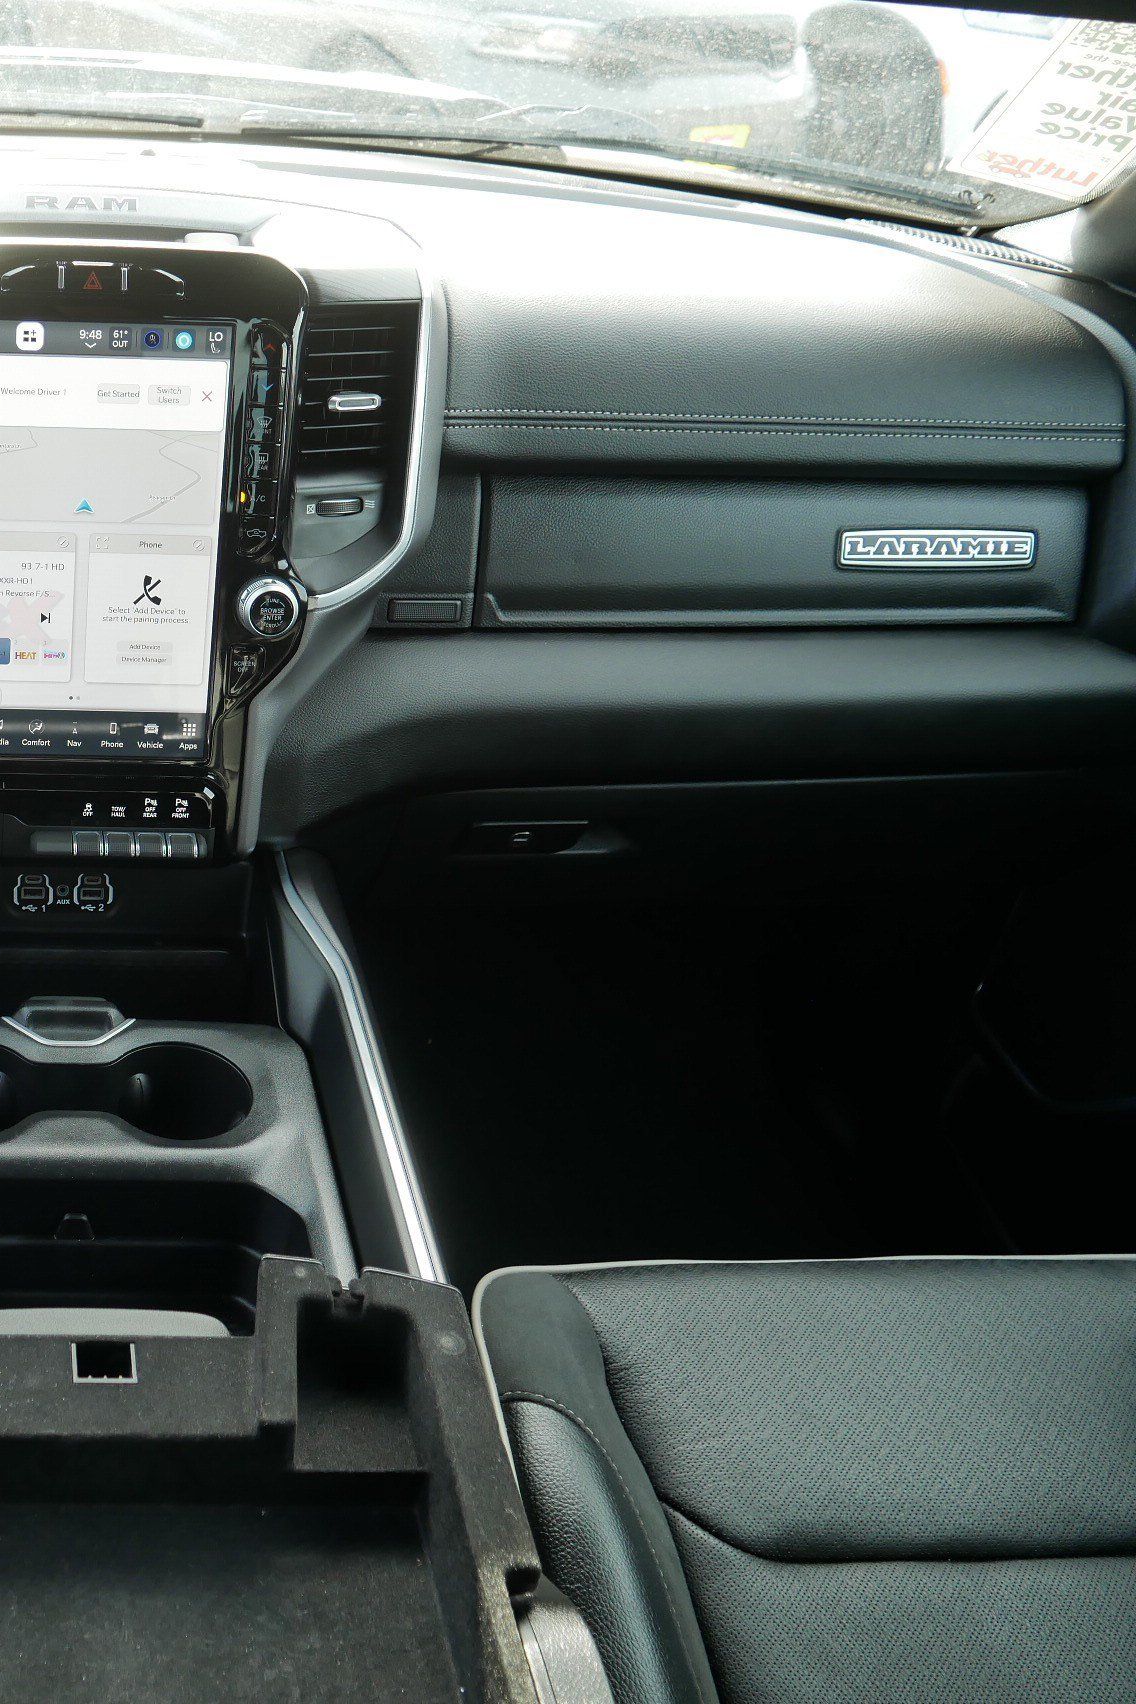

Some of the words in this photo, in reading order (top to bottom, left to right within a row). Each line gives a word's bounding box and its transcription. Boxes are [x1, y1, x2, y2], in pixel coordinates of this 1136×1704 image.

[25, 196, 137, 212] RAM
[79, 329, 102, 340] 9:48
[209, 332, 224, 342] LO
[0, 387, 36, 396] Welcome
[38, 388, 60, 396] Driver
[97, 389, 111, 398] Get
[112, 390, 140, 398] Started
[156, 386, 182, 395] Switch
[158, 396, 180, 404] Users
[139, 540, 162, 549] Phone
[845, 538, 1032, 558] LARAMIE
[51, 563, 65, 571] HD
[6, 589, 34, 597] Reverse
[108, 606, 130, 615] Select
[133, 616, 158, 624] pairing
[22, 738, 50, 747] Comfort
[137, 741, 164, 749] Vehicle
[179, 742, 197, 751] Apps
